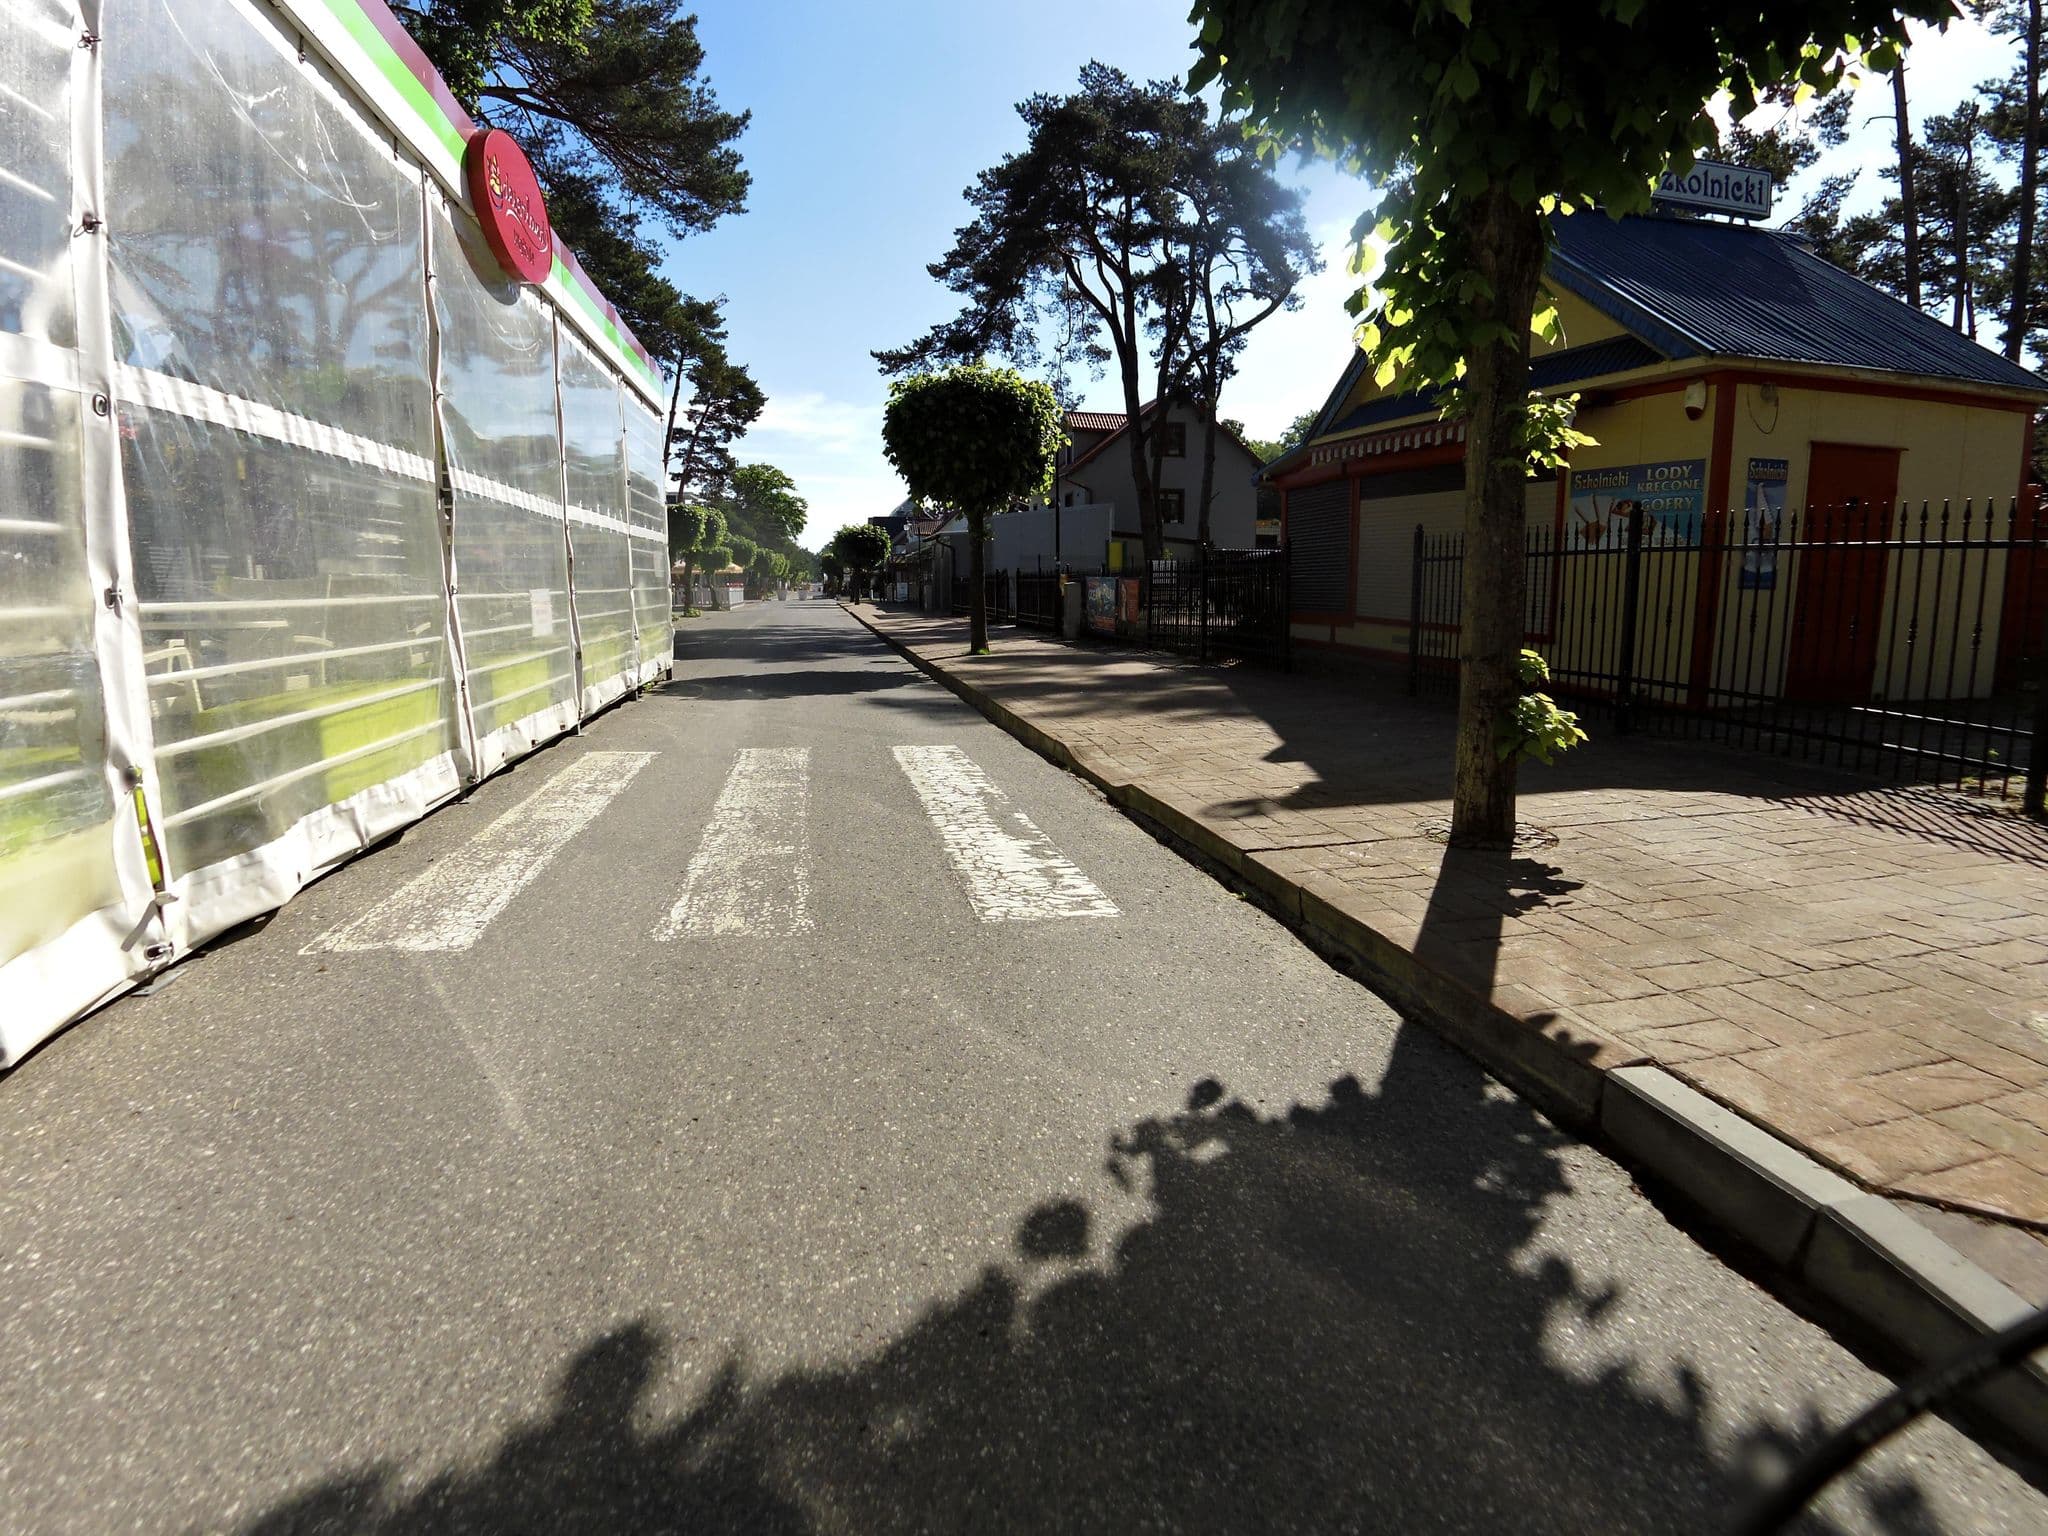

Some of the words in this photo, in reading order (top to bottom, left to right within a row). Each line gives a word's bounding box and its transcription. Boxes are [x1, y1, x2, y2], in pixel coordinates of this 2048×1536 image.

[1660, 169, 1763, 205] zkolnicki
[1574, 471, 1630, 489] Szkolnicki
[1647, 465, 1693, 481] LODY
[1641, 497, 1694, 511] GOFRY
